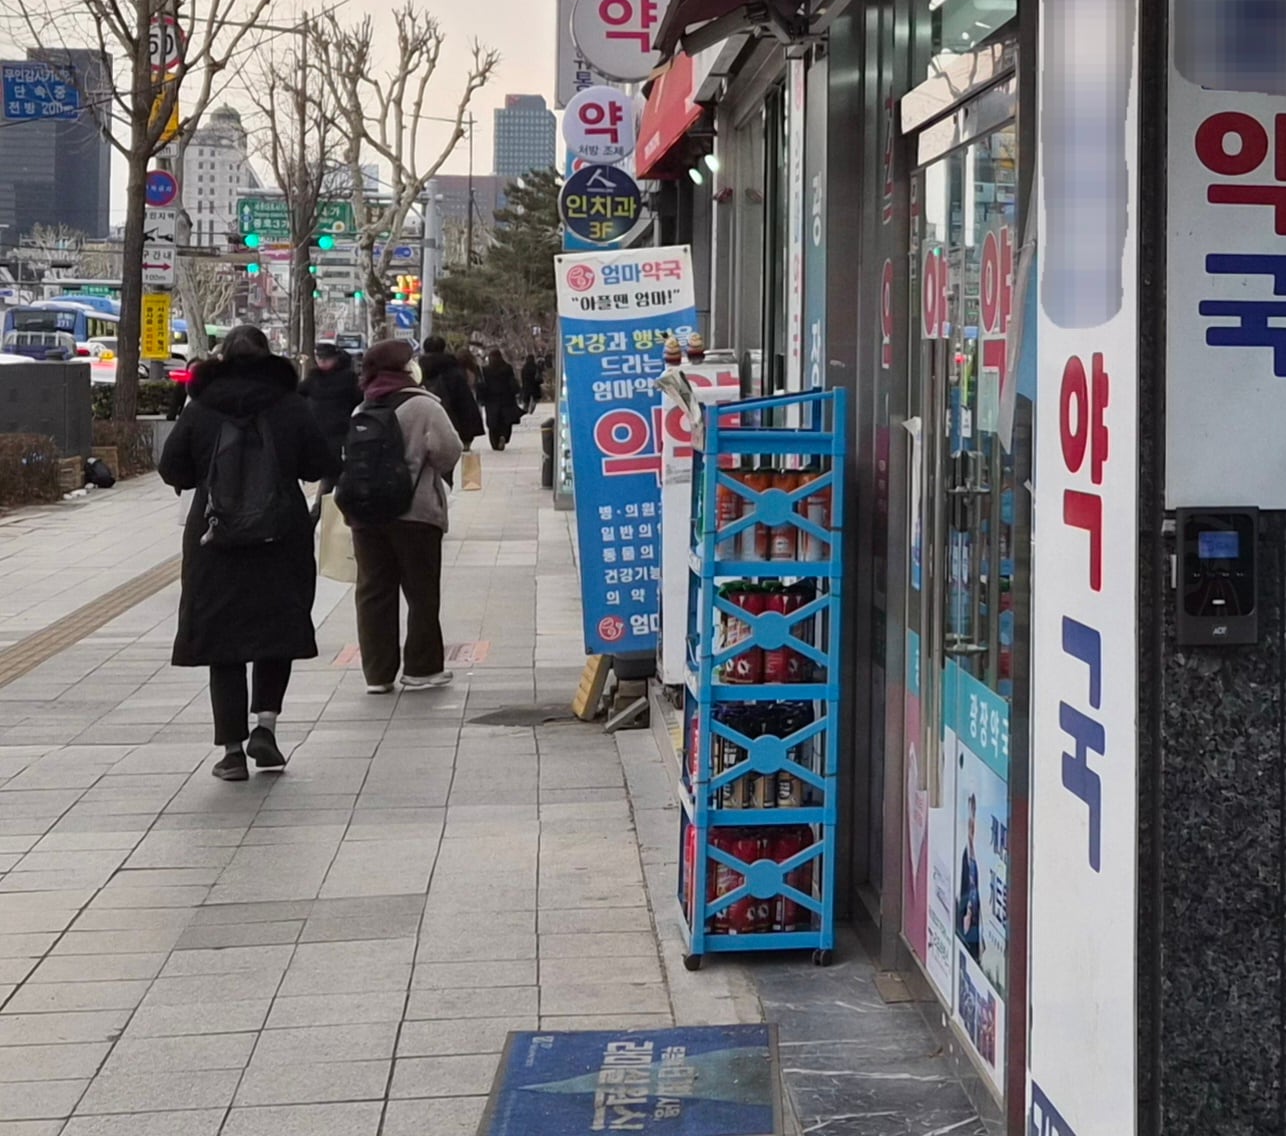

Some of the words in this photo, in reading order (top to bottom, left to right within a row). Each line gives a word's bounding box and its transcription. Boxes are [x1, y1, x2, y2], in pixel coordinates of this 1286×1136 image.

[579, 101, 623, 144] 약
[566, 195, 637, 219] 인치과
[589, 222, 614, 239] 3F
[601, 260, 682, 286] 엄마약국
[564, 331, 629, 355] 건강과
[601, 355, 663, 376] 드리는
[593, 377, 662, 402] 엄마약
[1058, 352, 1109, 874] 약국
